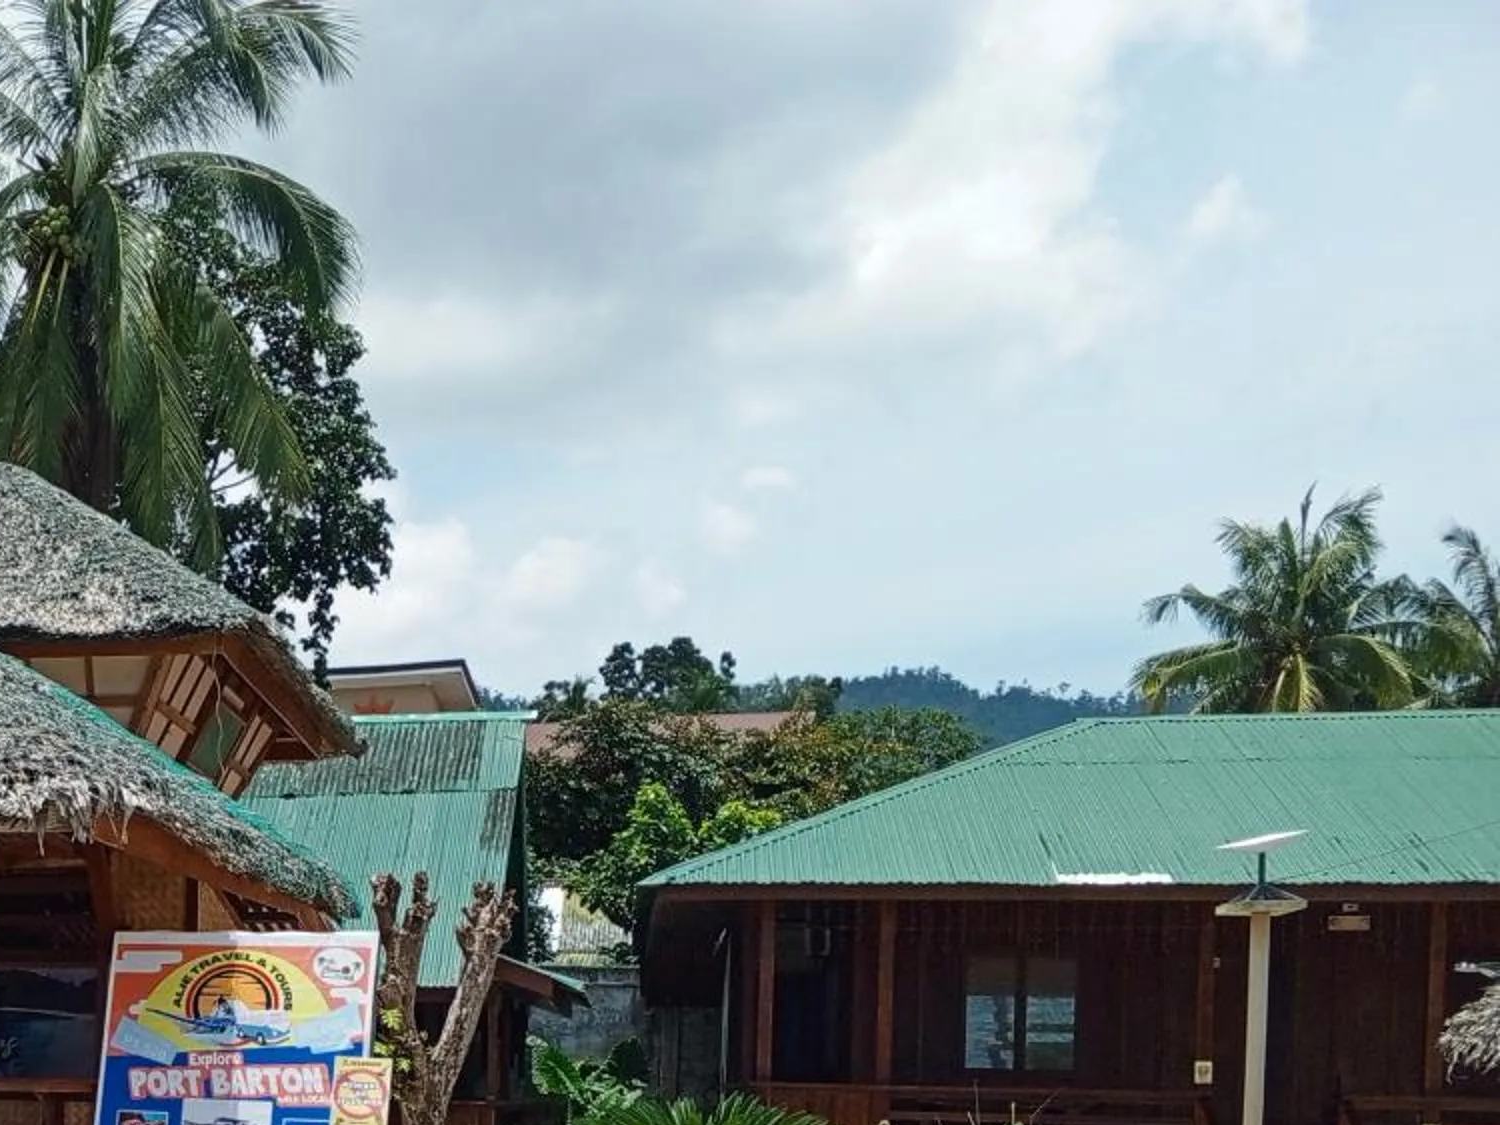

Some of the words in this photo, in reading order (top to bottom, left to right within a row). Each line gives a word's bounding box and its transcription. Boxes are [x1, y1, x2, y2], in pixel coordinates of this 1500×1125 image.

[190, 952, 254, 973] TRAVEL
[269, 965, 293, 1011] TOURS
[188, 1053, 241, 1068] Explore
[130, 1067, 200, 1097] PORT
[210, 1065, 325, 1097] BARTON
